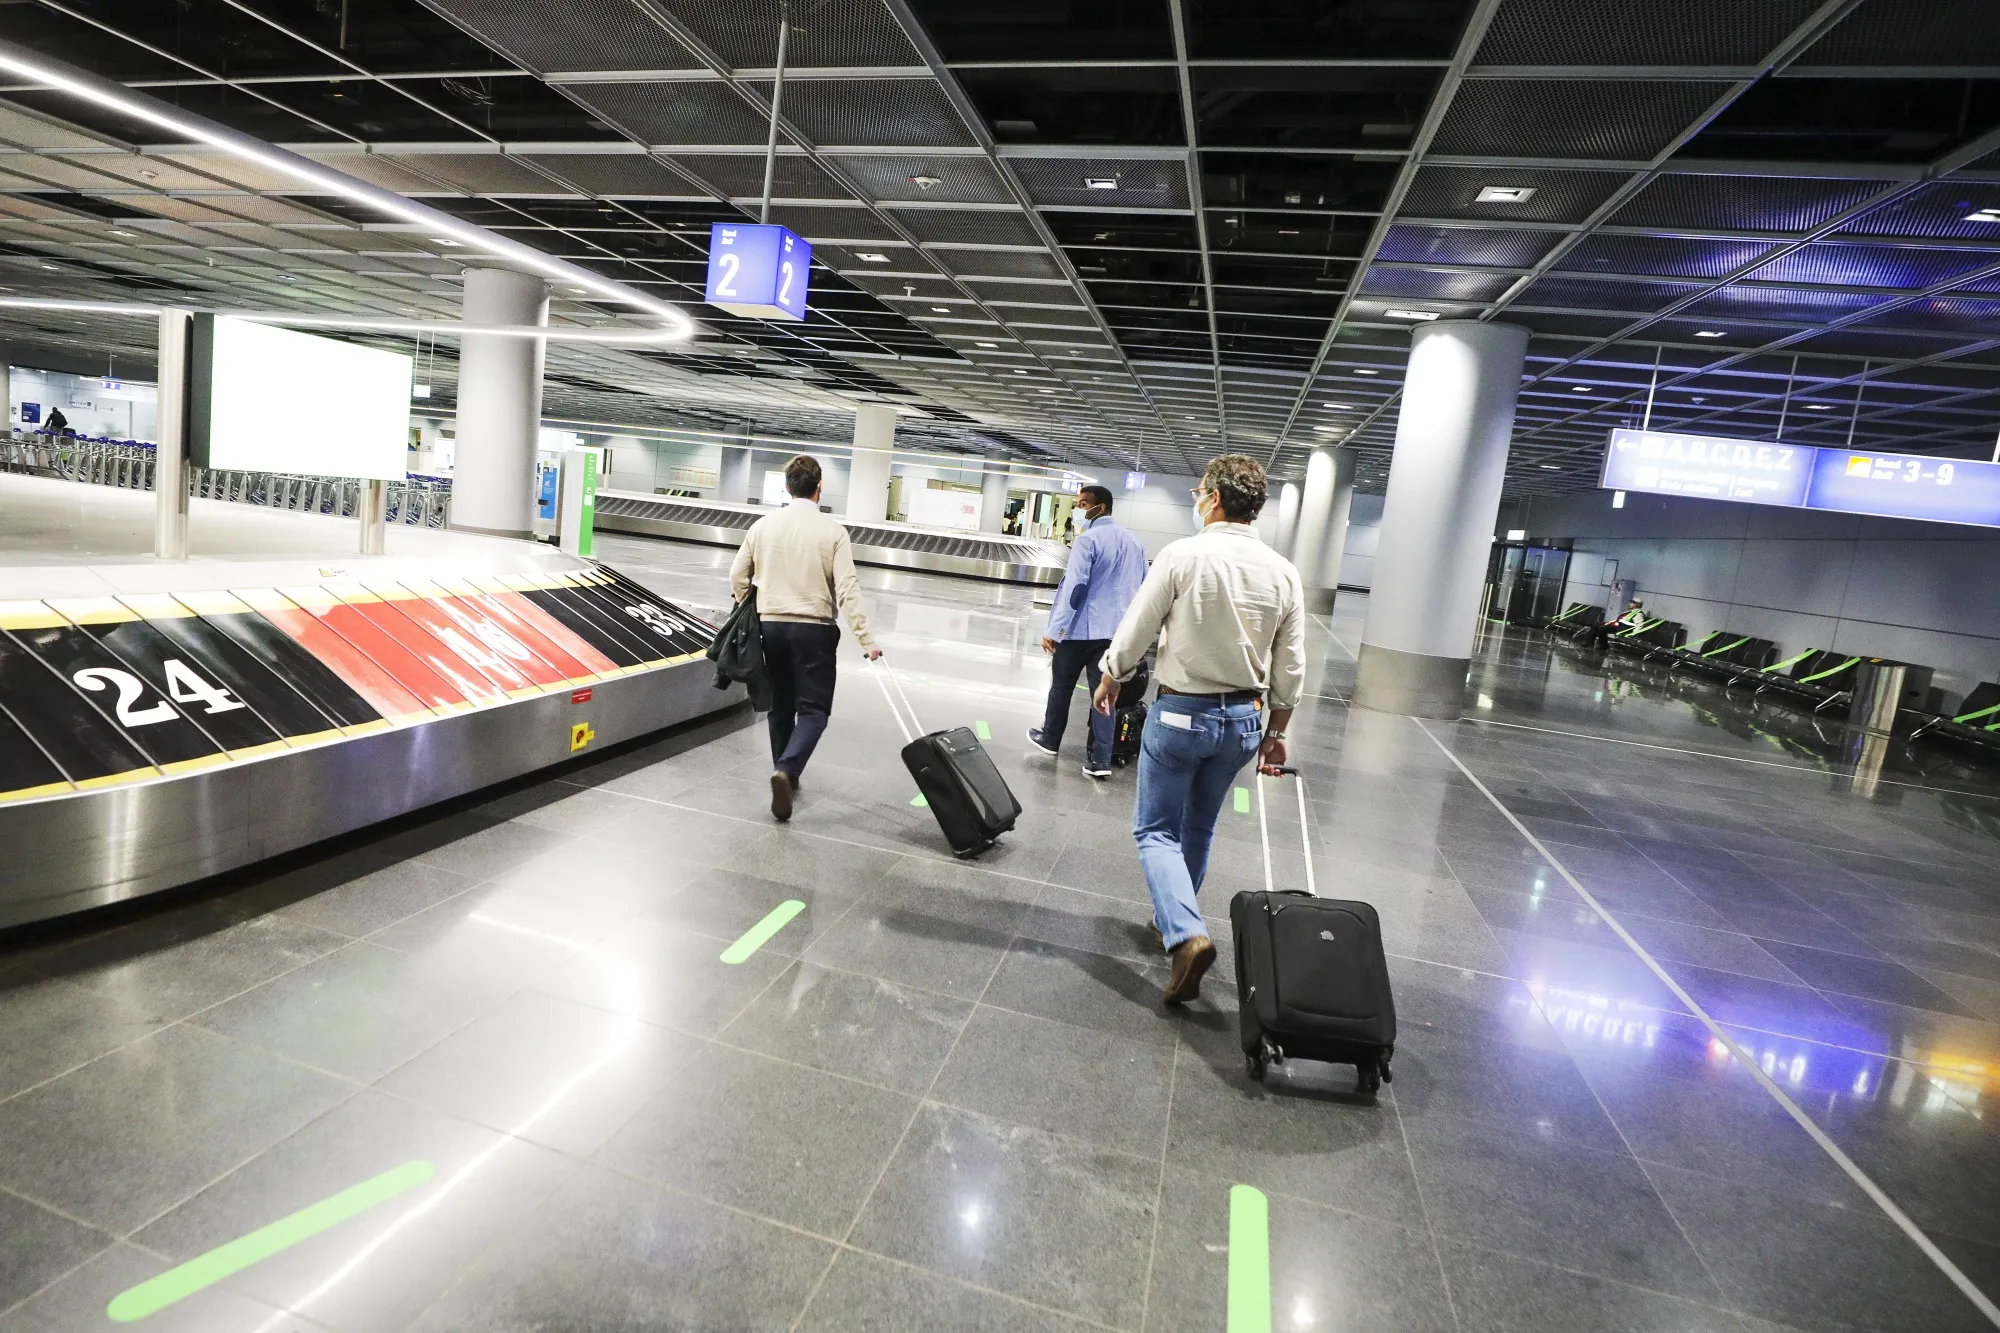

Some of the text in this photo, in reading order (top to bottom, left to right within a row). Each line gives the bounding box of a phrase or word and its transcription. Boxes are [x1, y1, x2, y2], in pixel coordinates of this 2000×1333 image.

[715, 253, 740, 297] 2
[779, 261, 793, 306] 2
[624, 603, 686, 636] 33
[72, 658, 246, 728] 24
